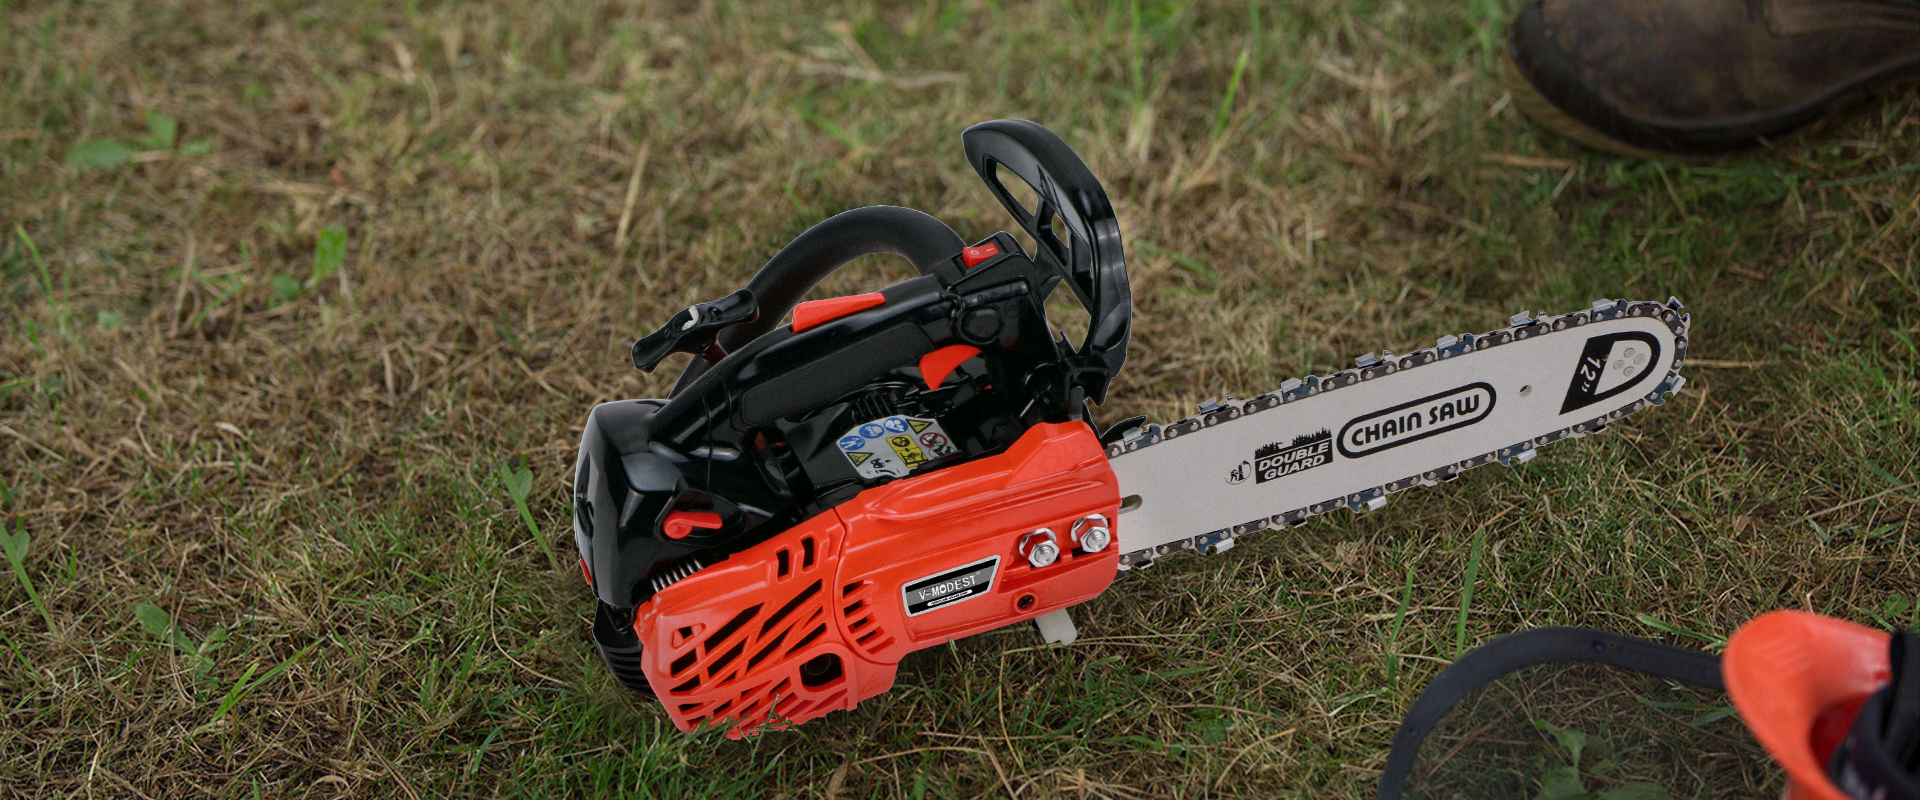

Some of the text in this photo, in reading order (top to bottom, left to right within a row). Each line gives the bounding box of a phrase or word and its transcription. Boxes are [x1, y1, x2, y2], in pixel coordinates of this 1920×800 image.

[1352, 394, 1479, 446] CHAIN SAW
[1259, 442, 1329, 471] DOUBLE
[1264, 455, 1325, 480] GUARD
